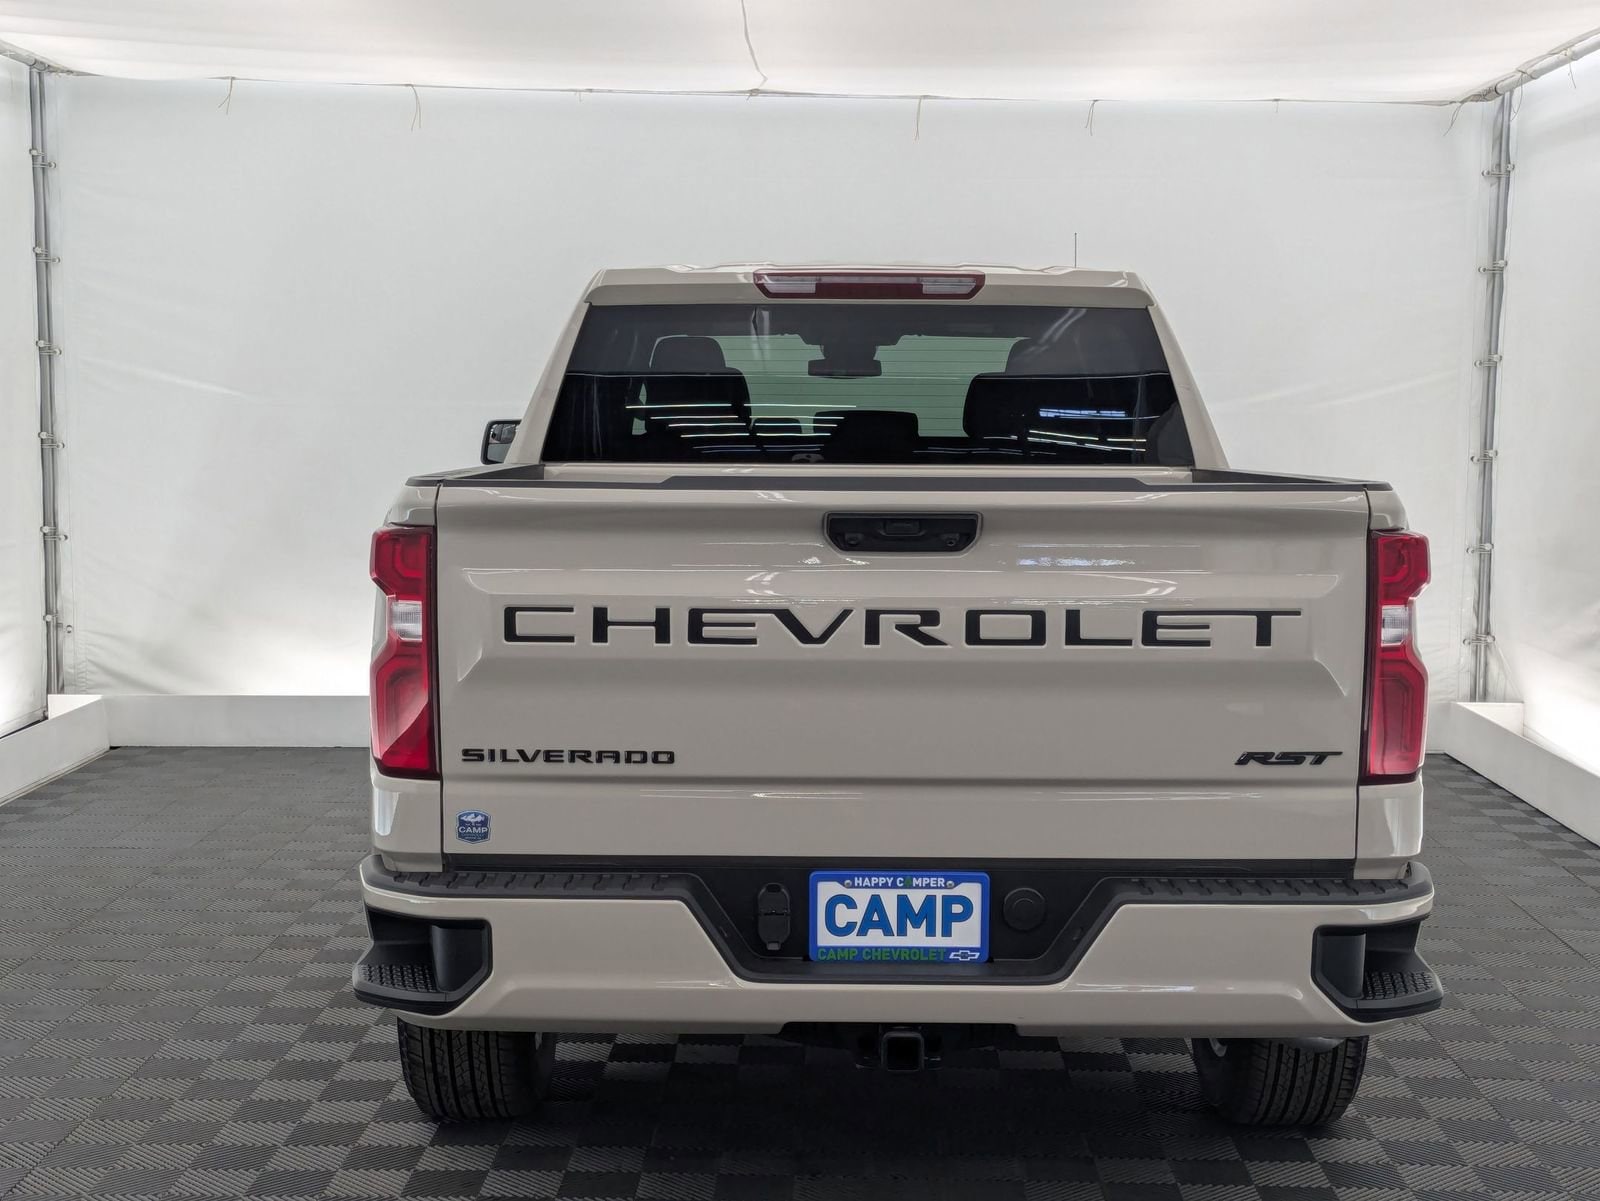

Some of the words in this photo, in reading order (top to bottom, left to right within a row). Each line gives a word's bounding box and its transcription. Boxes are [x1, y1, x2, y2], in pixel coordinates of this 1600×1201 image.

[504, 606, 1302, 648] CHEVROLET
[461, 748, 676, 765] SILVERADO
[1235, 751, 1344, 766] RST
[854, 877, 894, 887] HAPPY
[824, 893, 974, 938] CAMP
[817, 947, 858, 961] CAMP
[862, 947, 946, 961] CHEVROLET
